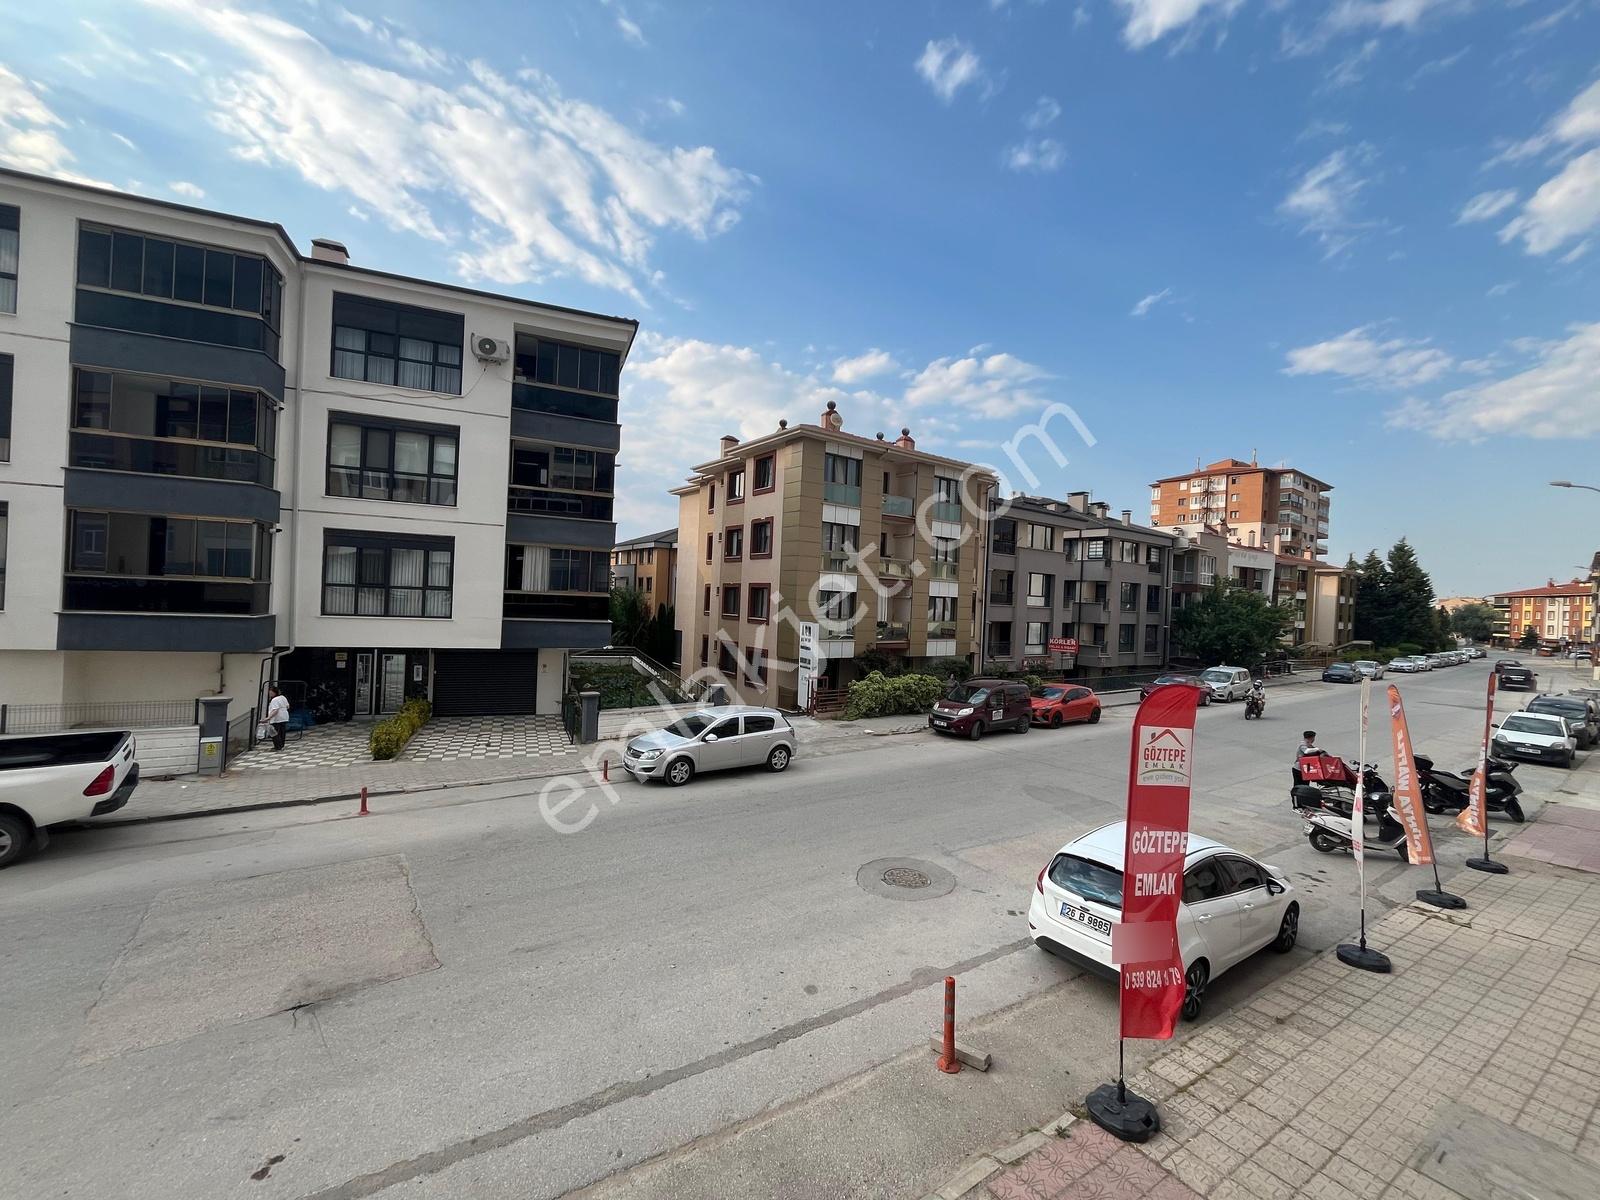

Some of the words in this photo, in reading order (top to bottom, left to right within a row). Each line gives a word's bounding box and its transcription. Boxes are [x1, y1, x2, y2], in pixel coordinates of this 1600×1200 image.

[1143, 746, 1186, 763] GÖZTEPE
[1132, 826, 1188, 854] GÖZTEPE
[1134, 872, 1178, 897] EMLAK
[1065, 907, 1076, 918] 26
[1078, 912, 1086, 922] B
[1087, 916, 1110, 932] 9885
[1124, 972, 1130, 990] 0
[1131, 971, 1145, 989] 539
[1146, 970, 1162, 988] 824
[1168, 966, 1182, 986] 79
